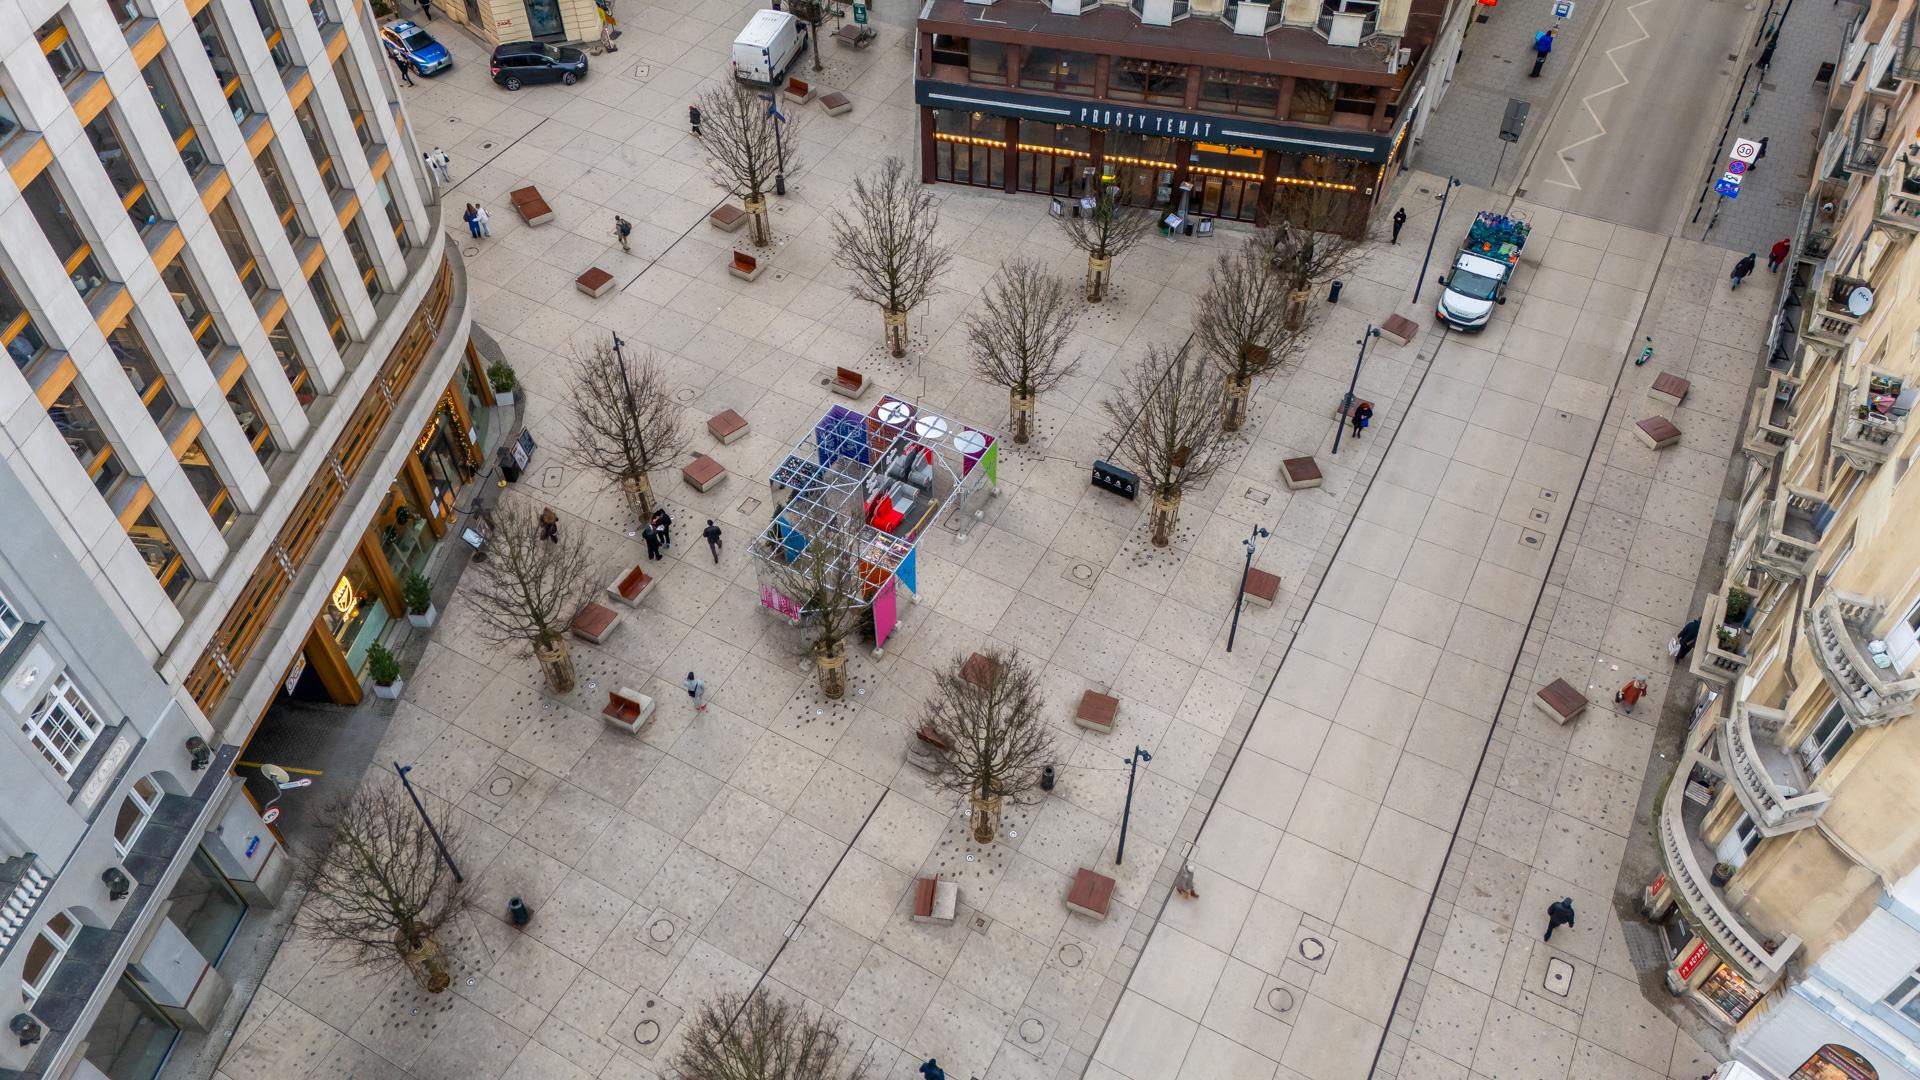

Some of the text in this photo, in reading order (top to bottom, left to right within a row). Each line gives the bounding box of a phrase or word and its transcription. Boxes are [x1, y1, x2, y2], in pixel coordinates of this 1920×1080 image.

[1081, 108, 1211, 136] PROSTY TEMAT
[1739, 146, 1752, 155] 30
